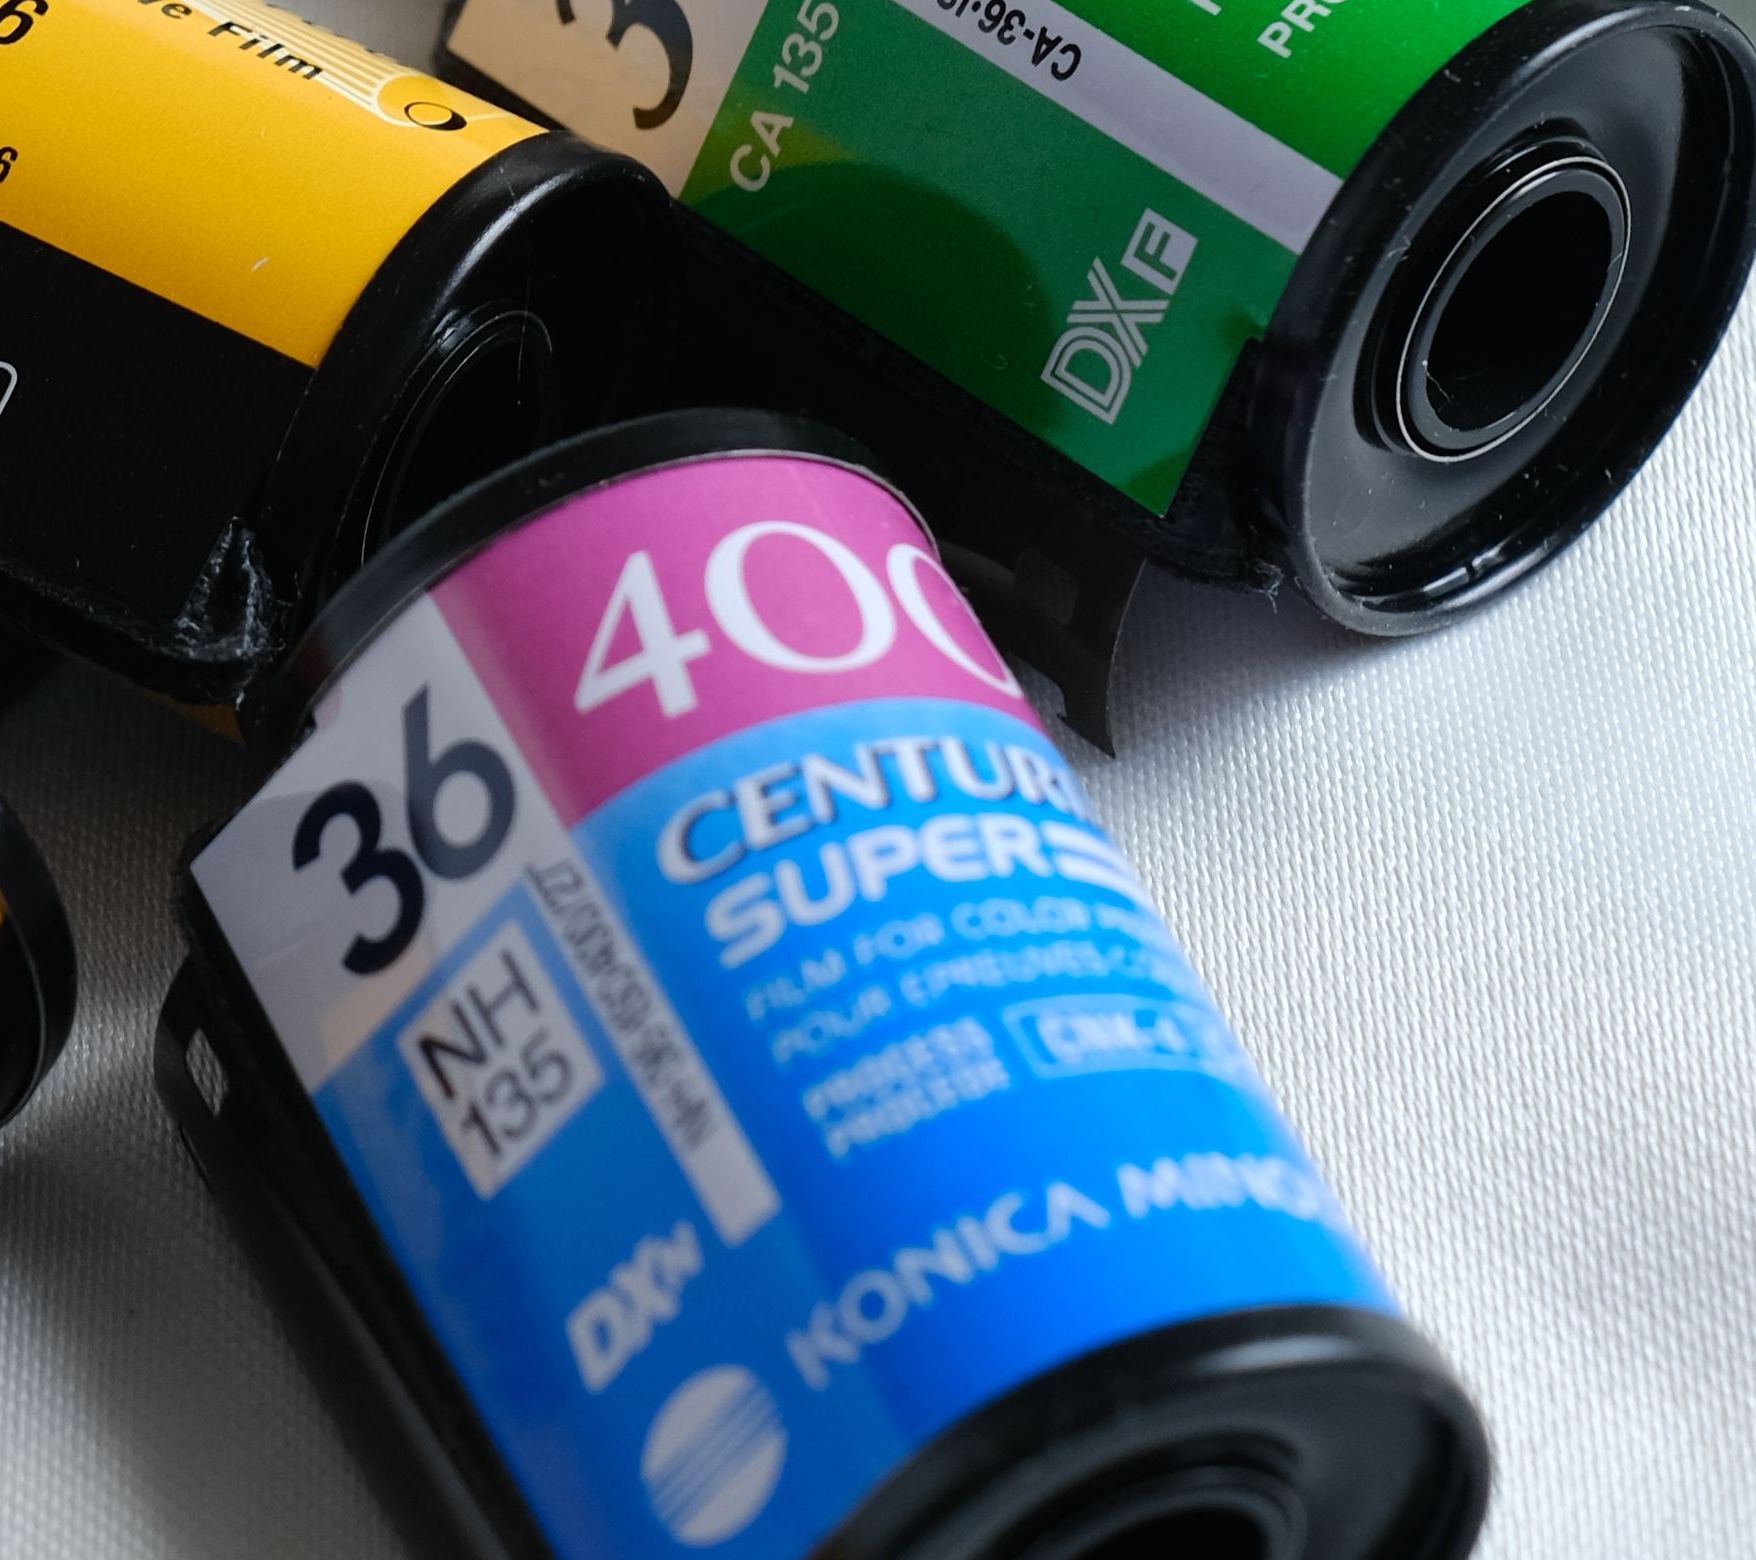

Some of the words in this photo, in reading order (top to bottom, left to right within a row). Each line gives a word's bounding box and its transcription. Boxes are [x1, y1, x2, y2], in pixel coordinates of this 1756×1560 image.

[207, 15, 327, 83] Film
[730, 110, 795, 191] CA
[288, 695, 521, 979] 36
[702, 812, 1047, 969] SUPER
[394, 954, 538, 1105] NH
[436, 1032, 571, 1161] 135
[785, 1179, 1114, 1391] KONICA
